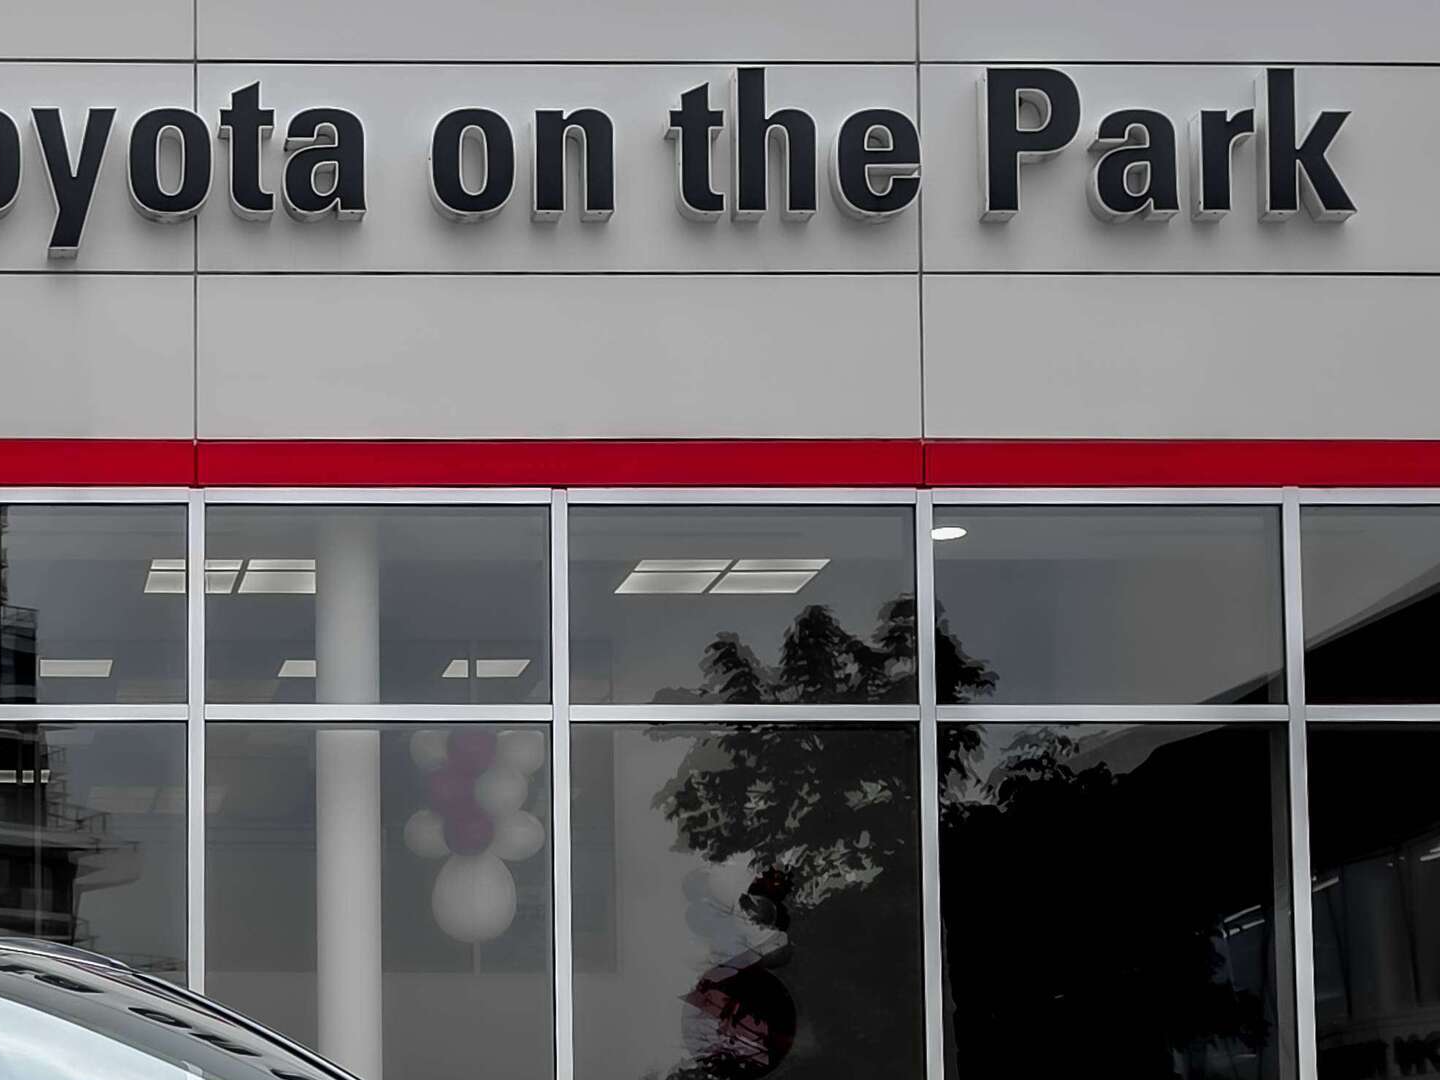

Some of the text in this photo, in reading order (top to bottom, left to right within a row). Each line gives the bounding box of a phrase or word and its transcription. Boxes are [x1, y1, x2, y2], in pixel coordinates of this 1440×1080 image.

[428, 106, 615, 223] on
[664, 66, 922, 222] the
[976, 67, 1358, 222] Park
